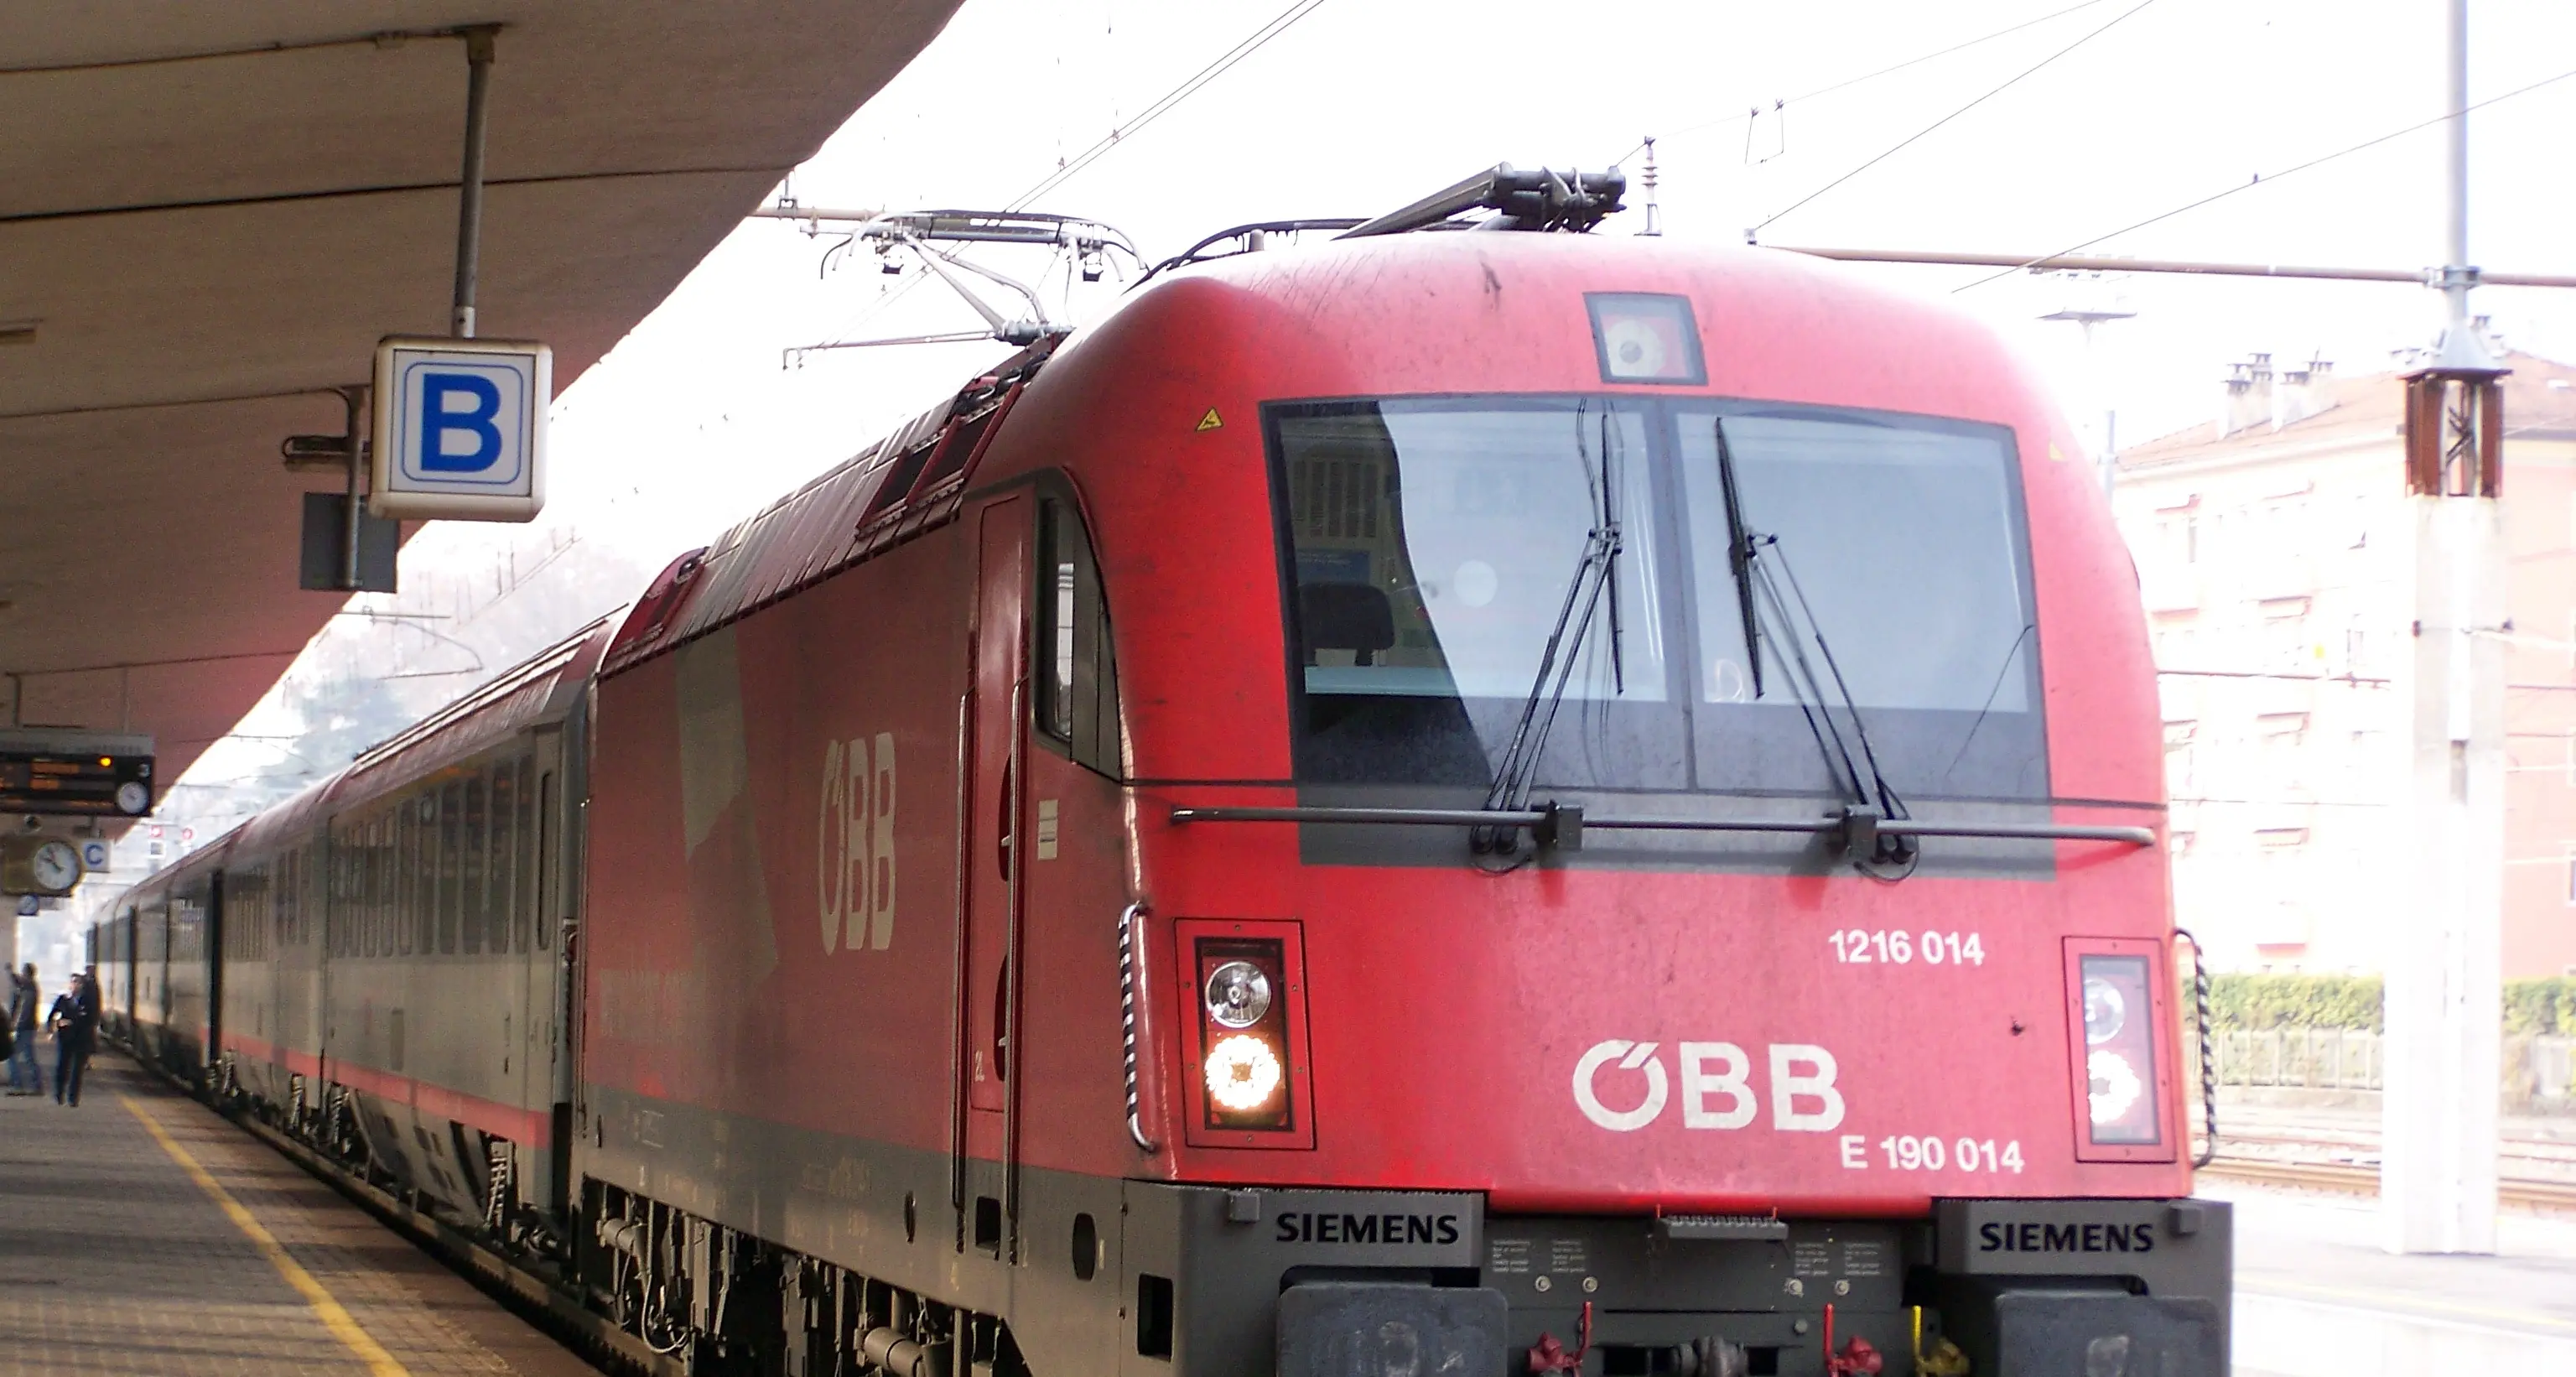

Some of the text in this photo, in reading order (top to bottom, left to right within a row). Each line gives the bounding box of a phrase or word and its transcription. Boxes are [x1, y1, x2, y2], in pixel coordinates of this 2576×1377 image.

[421, 373, 502, 472] B
[86, 844, 104, 865] C
[819, 731, 896, 956] ÖBB
[1829, 929, 1985, 966] 1216 014
[1572, 1038, 1846, 1132] ÖBB
[1840, 1135, 2025, 1174] E 190 014
[1276, 1213, 1459, 1244] SIEMENS
[1979, 1222, 2153, 1252] SIEMENS
